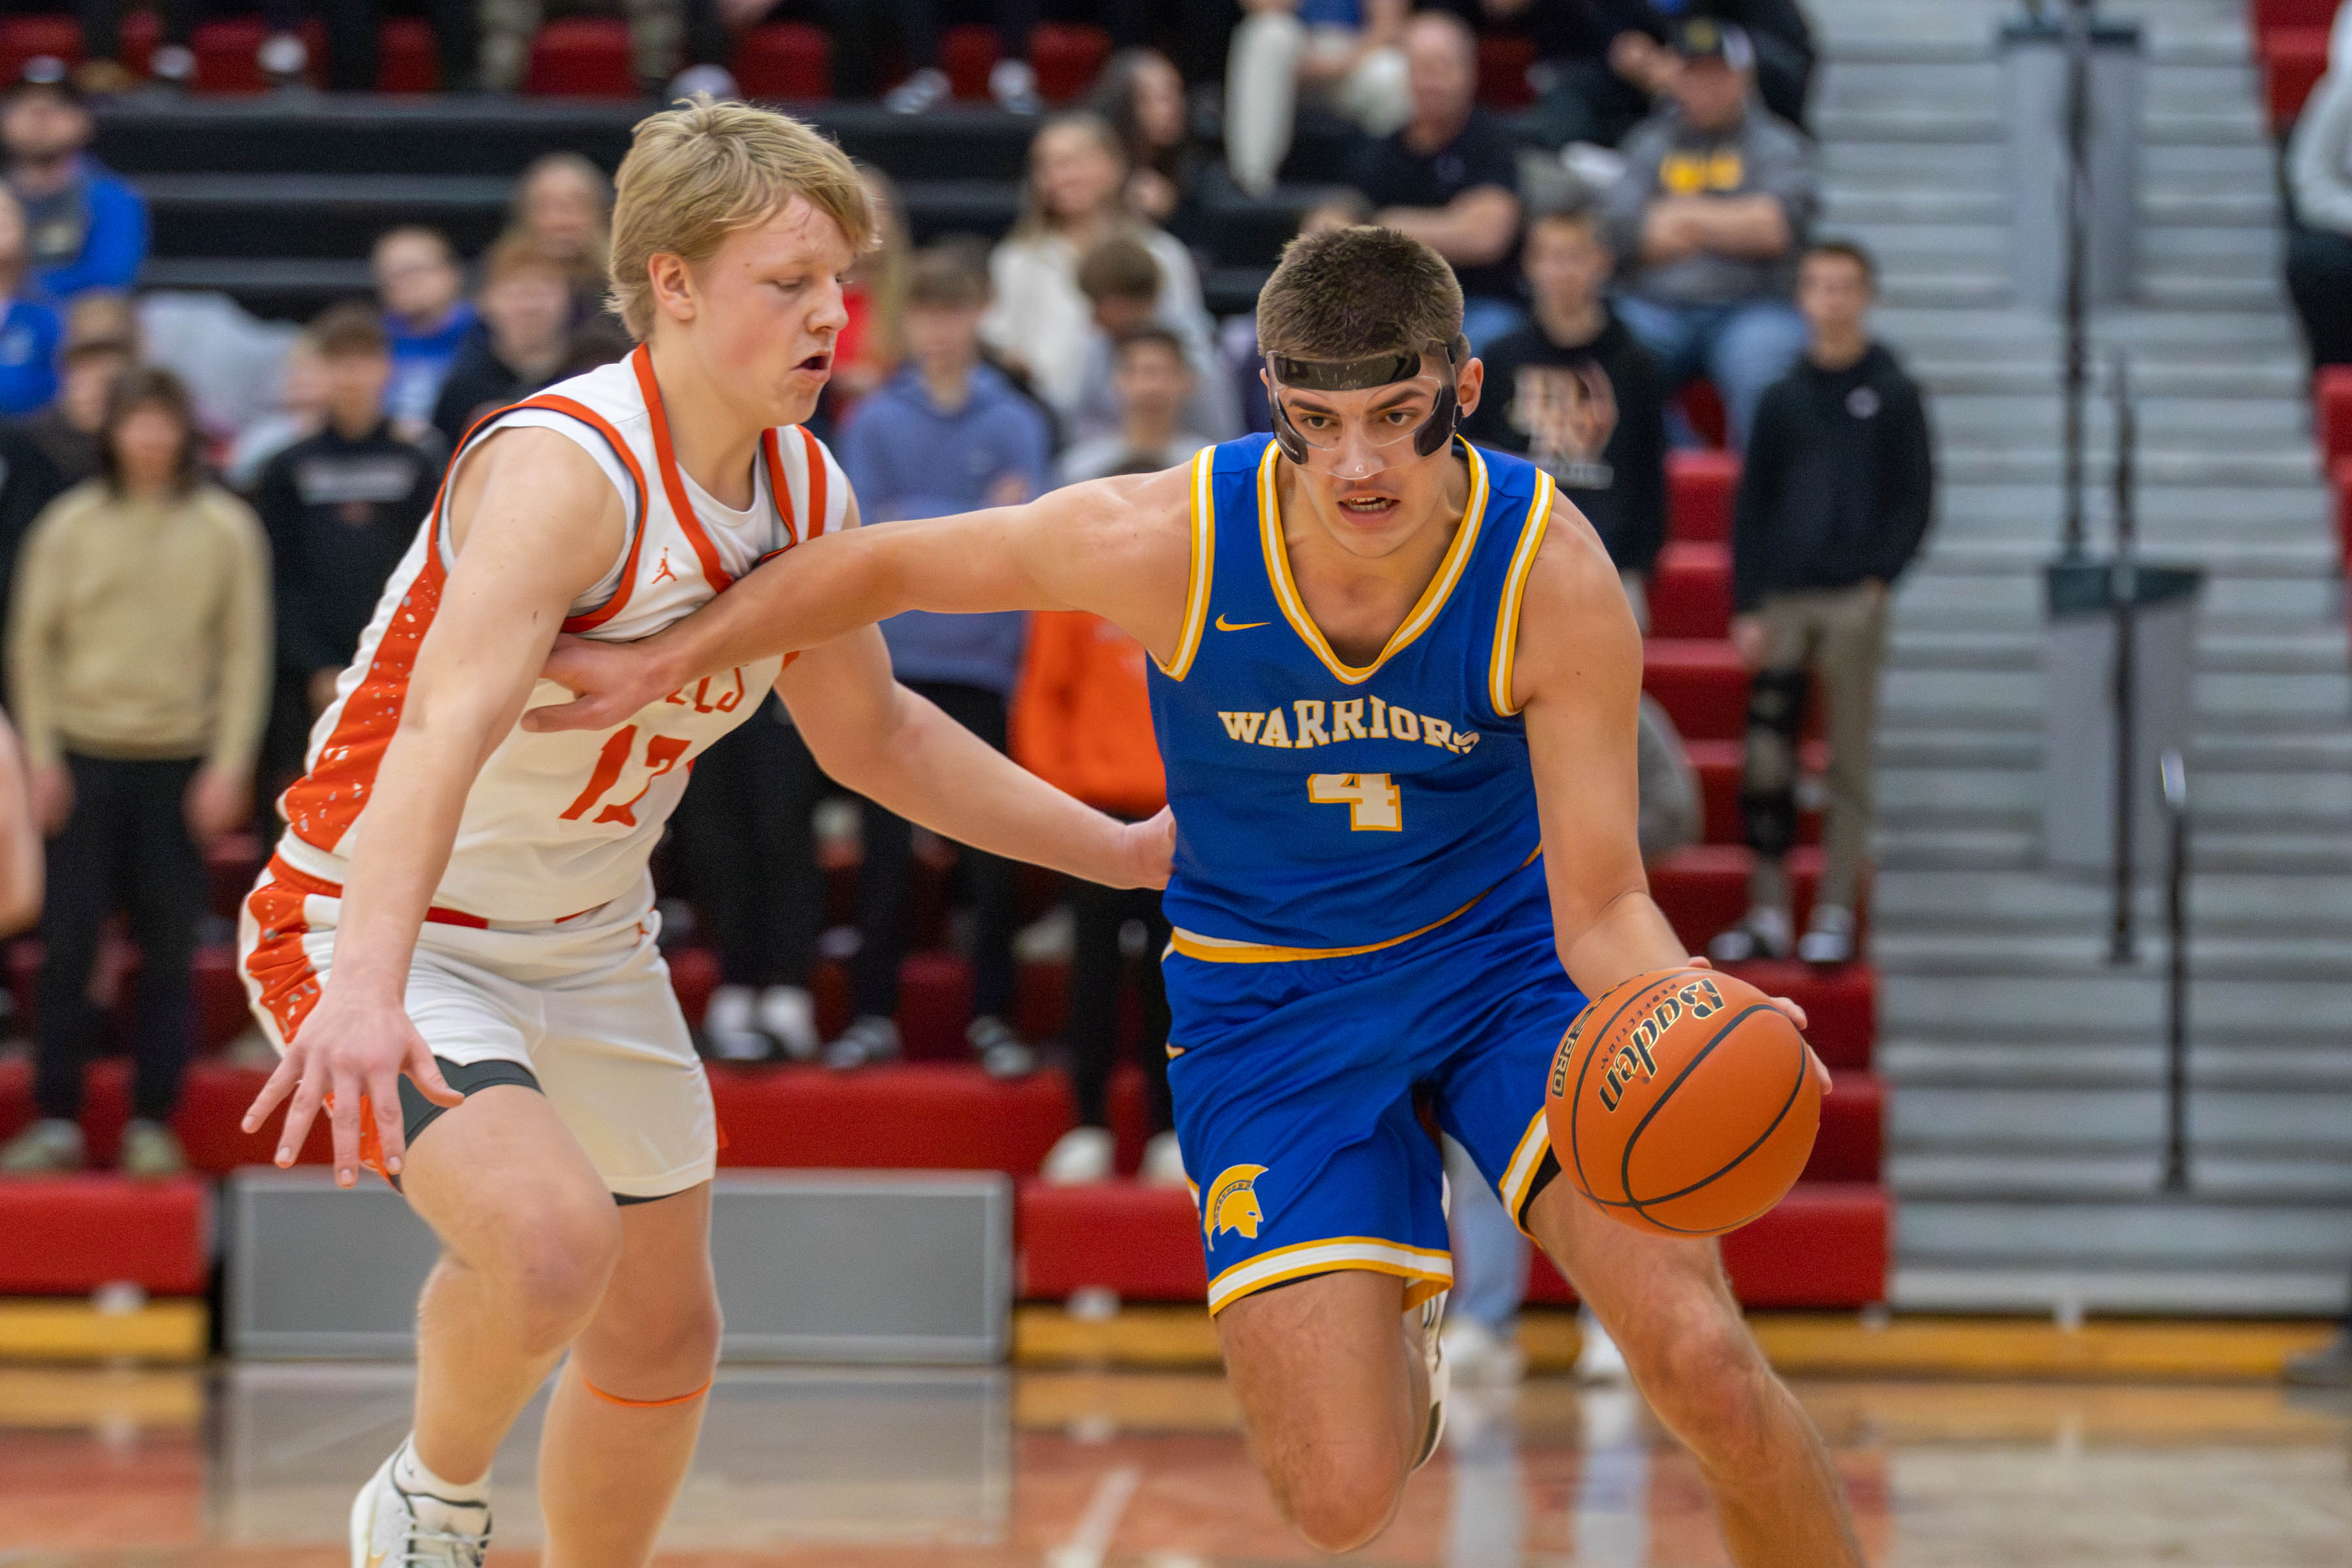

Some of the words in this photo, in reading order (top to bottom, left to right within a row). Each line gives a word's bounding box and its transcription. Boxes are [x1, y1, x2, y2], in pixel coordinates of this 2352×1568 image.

[1218, 695, 1480, 754] WARRIORS
[1307, 772, 1403, 832] 4
[1552, 1036, 1576, 1098] PRO
[1599, 977, 1725, 1113] Baden
